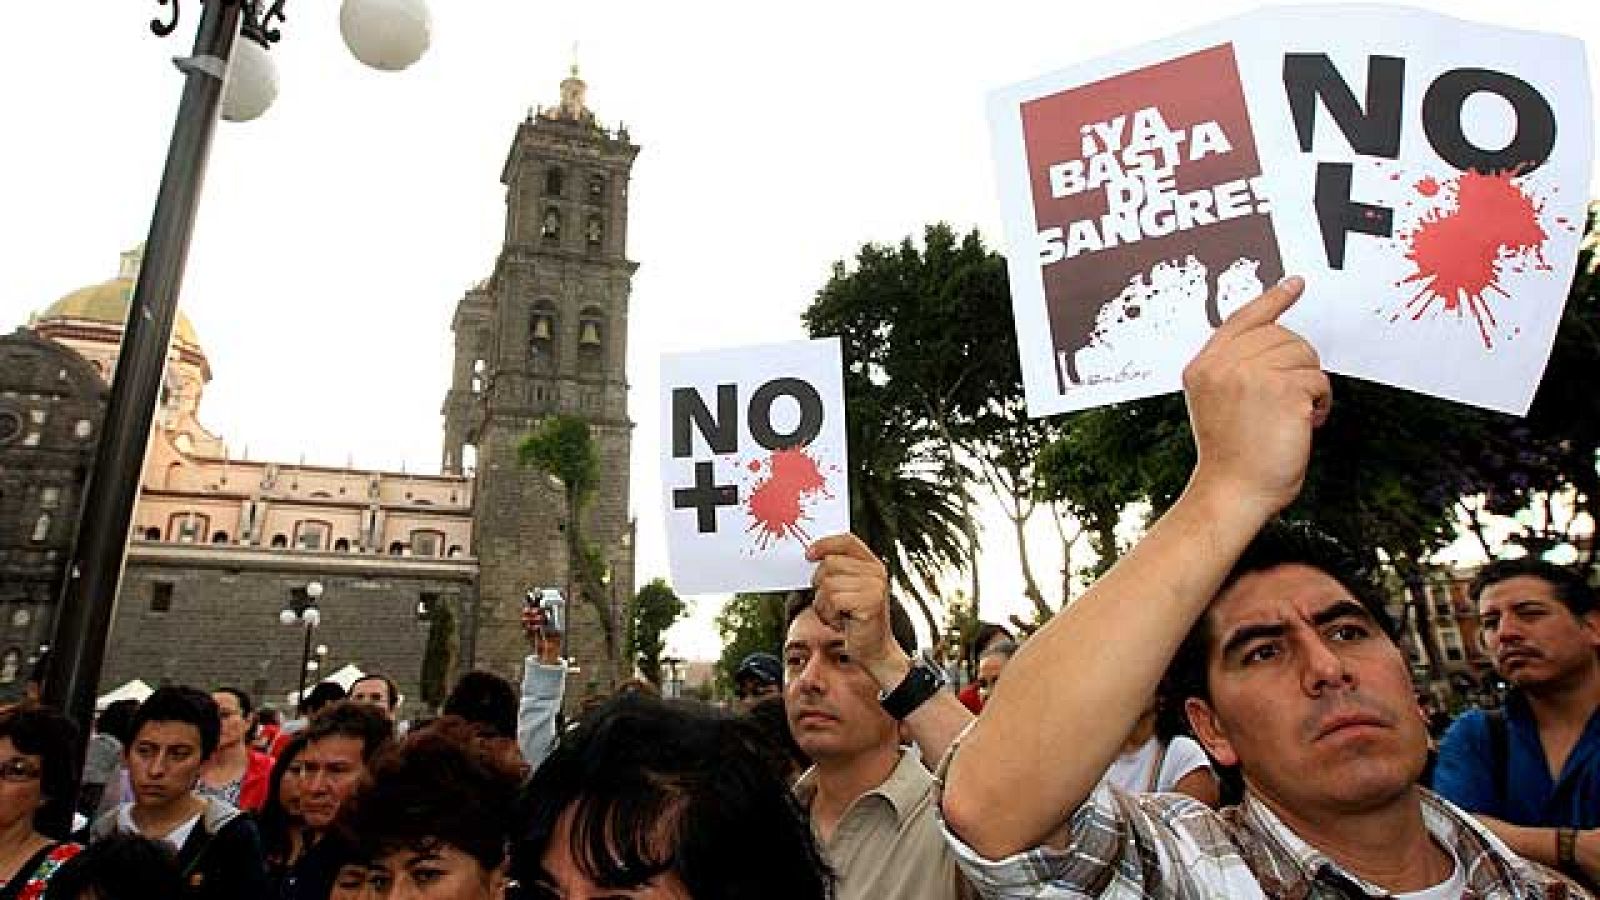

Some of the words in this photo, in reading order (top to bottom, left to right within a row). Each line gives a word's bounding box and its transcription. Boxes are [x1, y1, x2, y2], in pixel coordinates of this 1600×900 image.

[1282, 52, 1556, 177] NO
[1050, 120, 1234, 198] BASTA
[1107, 166, 1178, 216] DE
[672, 377, 823, 458] NO
